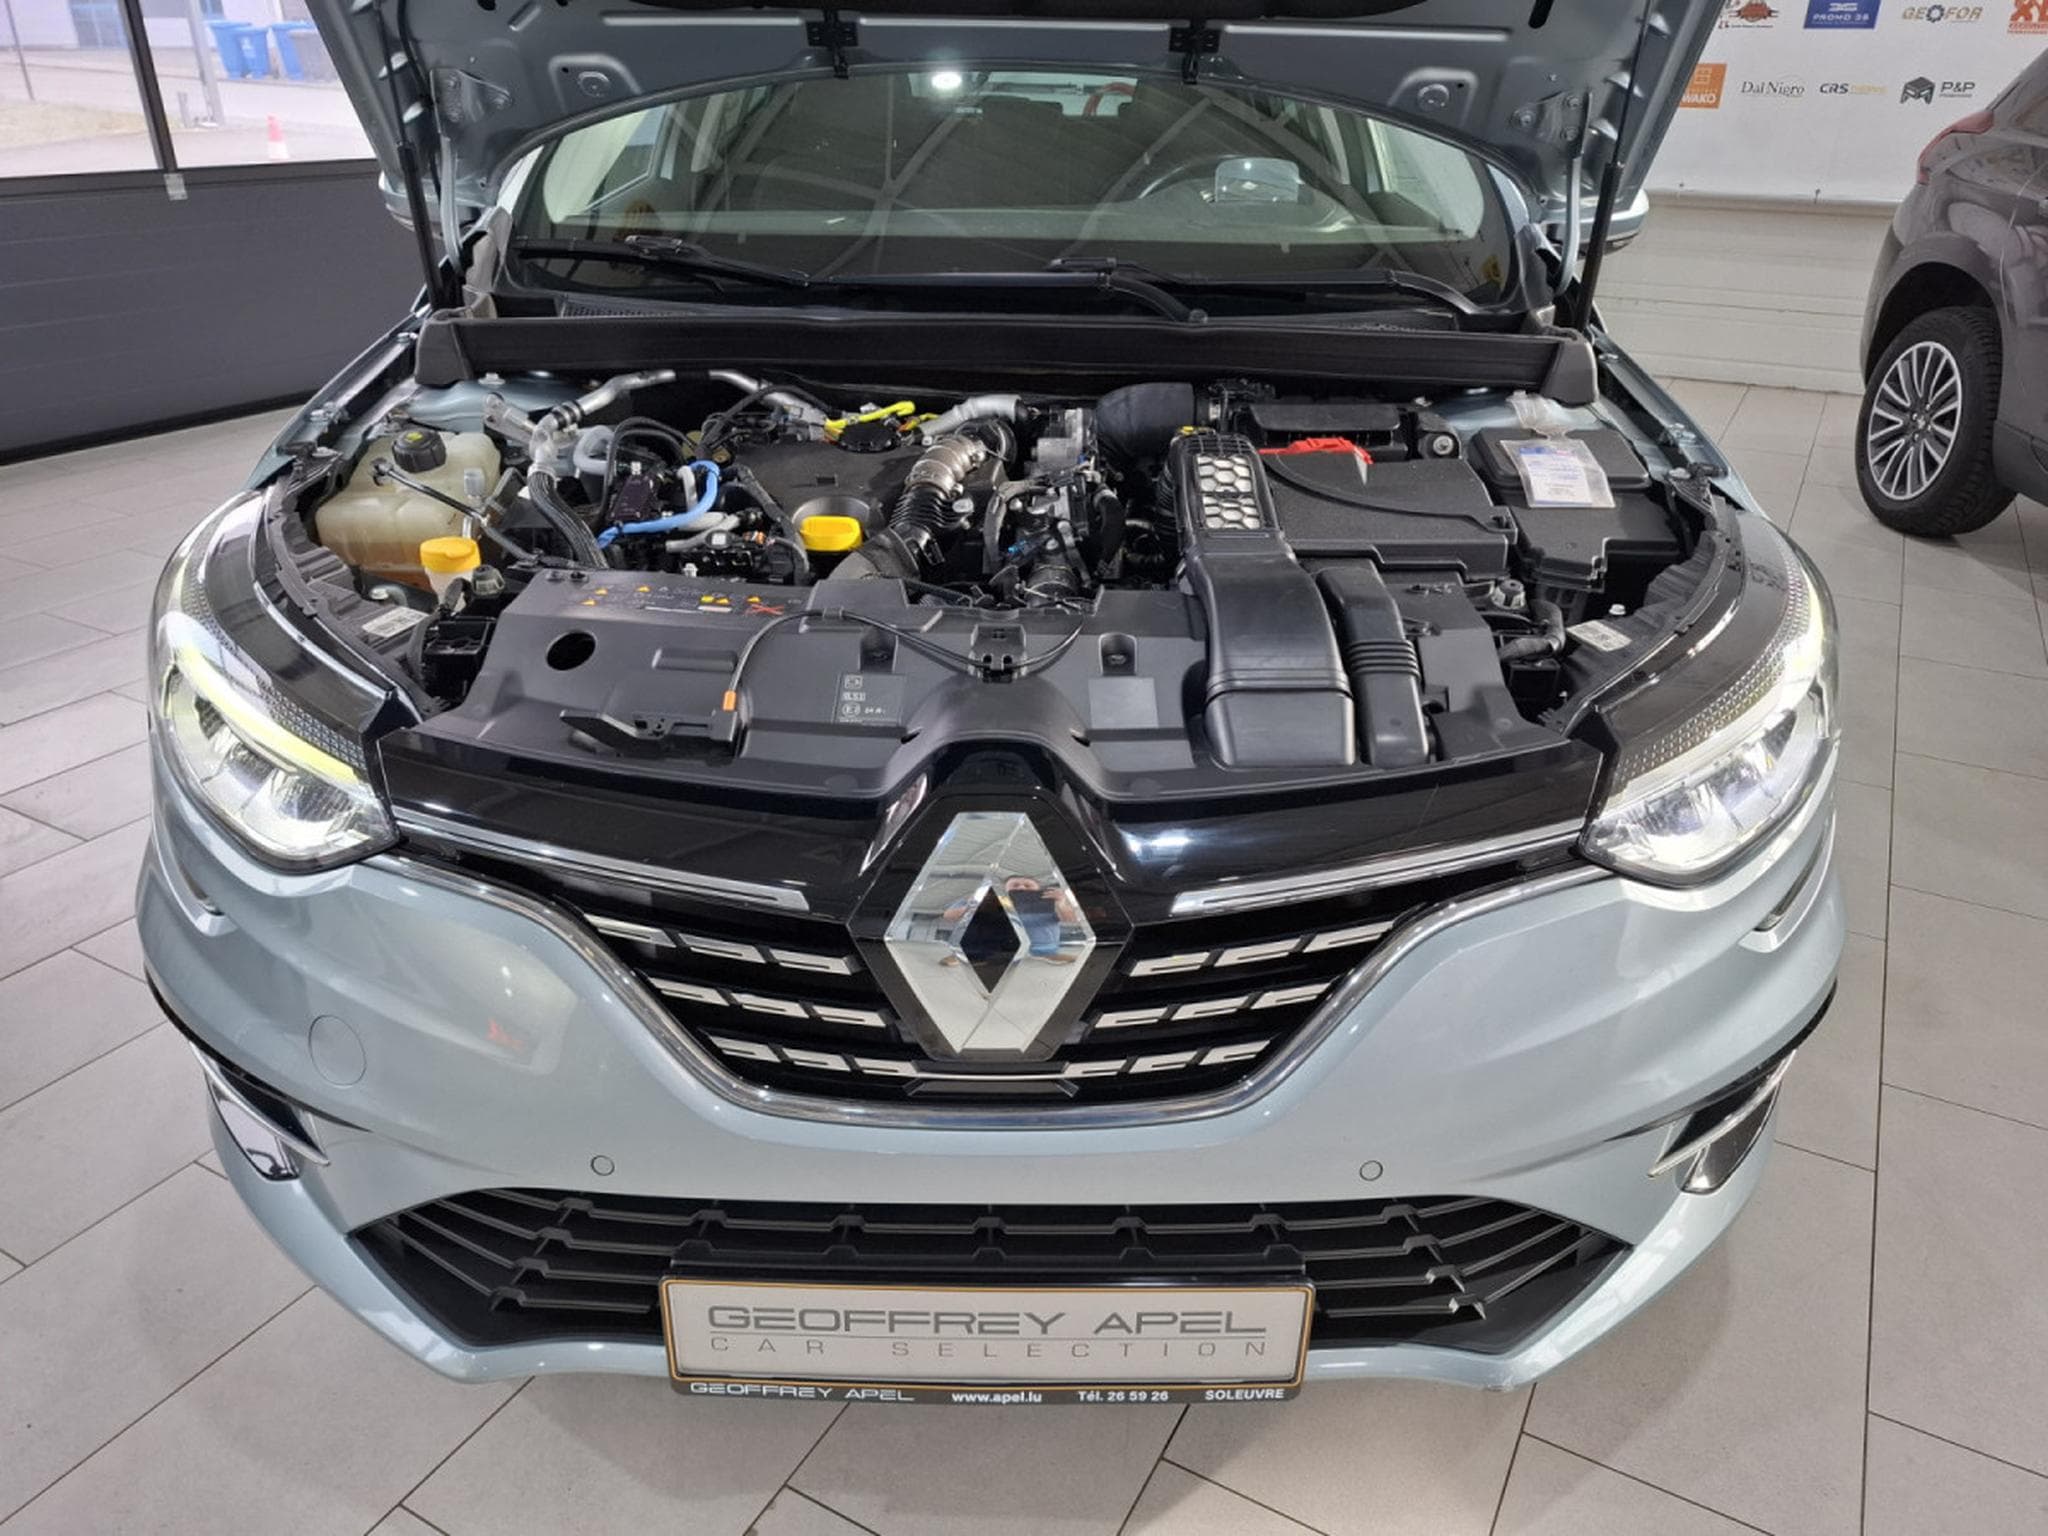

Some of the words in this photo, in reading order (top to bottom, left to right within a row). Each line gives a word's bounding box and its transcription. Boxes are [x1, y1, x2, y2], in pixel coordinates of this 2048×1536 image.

[1812, 13, 1852, 21] PROMO
[1902, 5, 1983, 22] GEOFOR
[1741, 81, 1765, 94] Dal
[1766, 81, 1805, 97] Nigro
[1819, 82, 1849, 95] CRS
[1940, 81, 1976, 93] P&P
[708, 1305, 1065, 1335] GEOFFREY
[1094, 1311, 1266, 1335] APEL
[711, 1337, 824, 1354] CAR
[892, 1342, 1266, 1358] SELECTION
[690, 1382, 832, 1399] GEOFFREY
[845, 1387, 915, 1402] APEL
[952, 1390, 1043, 1405] www.apel.lu
[1078, 1389, 1101, 1402] Tél.
[1107, 1391, 1126, 1402] 26
[1129, 1391, 1148, 1402] 59
[1150, 1391, 1169, 1402] 26
[1204, 1388, 1285, 1401] SOLEUVRE
